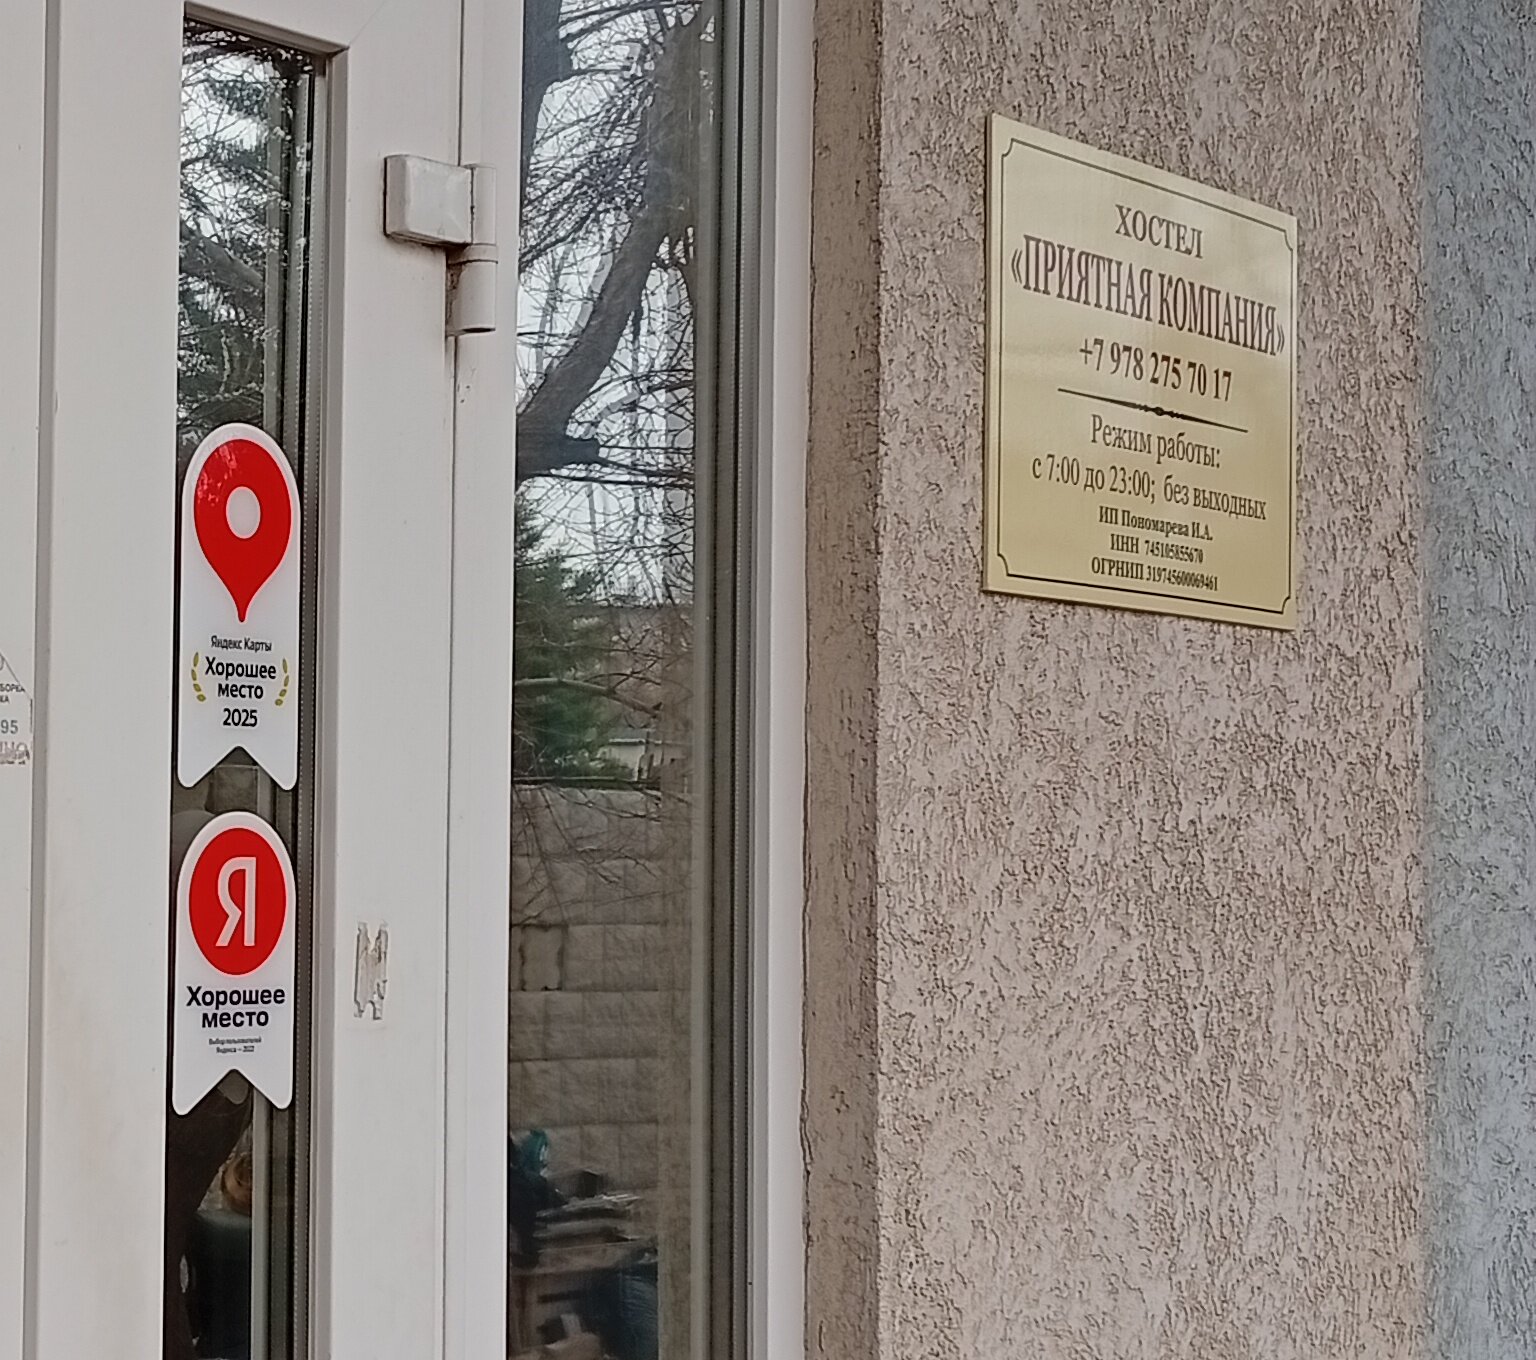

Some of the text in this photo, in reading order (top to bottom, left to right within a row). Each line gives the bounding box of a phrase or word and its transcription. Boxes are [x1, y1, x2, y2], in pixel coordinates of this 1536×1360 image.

[1115, 204, 1203, 259] ХОСТЕЛ
[1011, 234, 1285, 357] «ПРИЯТНАЯ КОМПАНИЯ»
[1079, 338, 1232, 402] +7 978 275 70 17
[1091, 414, 1220, 469] Режим работы:
[1032, 454, 1267, 520] с 7:00 до 23:00; без выходных
[1099, 505, 1118, 525] ИП
[1121, 509, 1189, 538] Пономарева
[1110, 533, 1139, 554] ИНН
[1091, 556, 1144, 580] ОГРНИП
[210, 635, 272, 653] Яндекс Карты
[205, 656, 277, 680] Хорошее
[218, 683, 264, 699] место
[0, 719, 19, 734] 95
[223, 707, 258, 727] 2025
[214, 856, 257, 947] Я
[186, 985, 285, 1010] Хорошее
[202, 1011, 269, 1028] место
